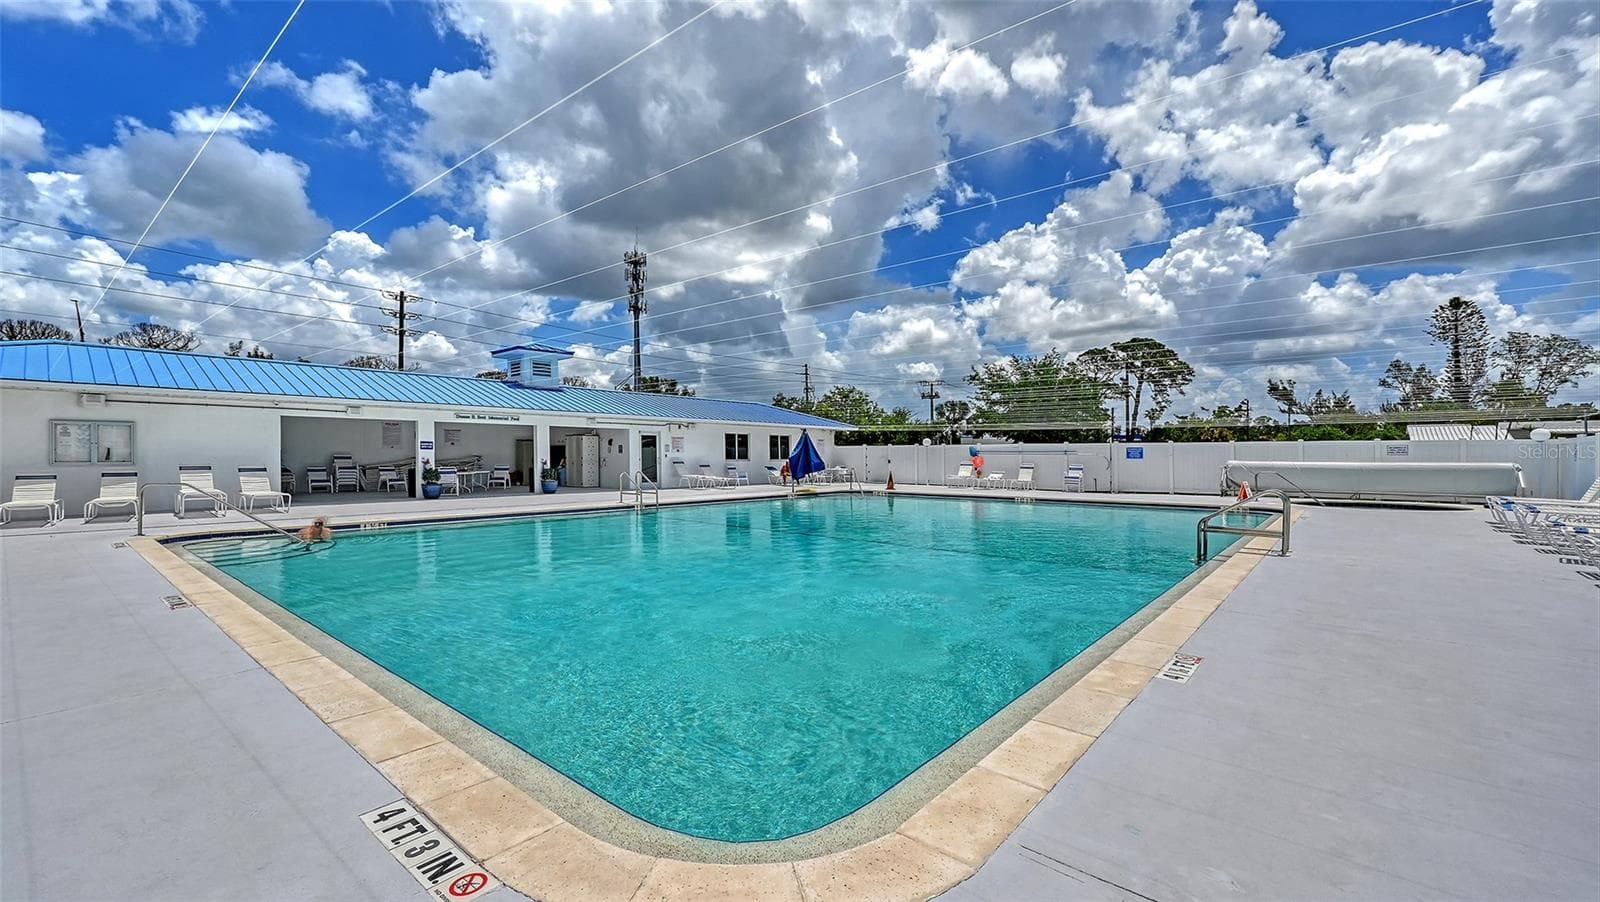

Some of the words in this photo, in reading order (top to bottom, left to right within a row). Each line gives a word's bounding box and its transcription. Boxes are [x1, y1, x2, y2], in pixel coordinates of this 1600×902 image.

[373, 807, 407, 824] 4
[382, 817, 428, 846] FT.
[404, 839, 440, 858] 3
[416, 851, 465, 885] IN.
